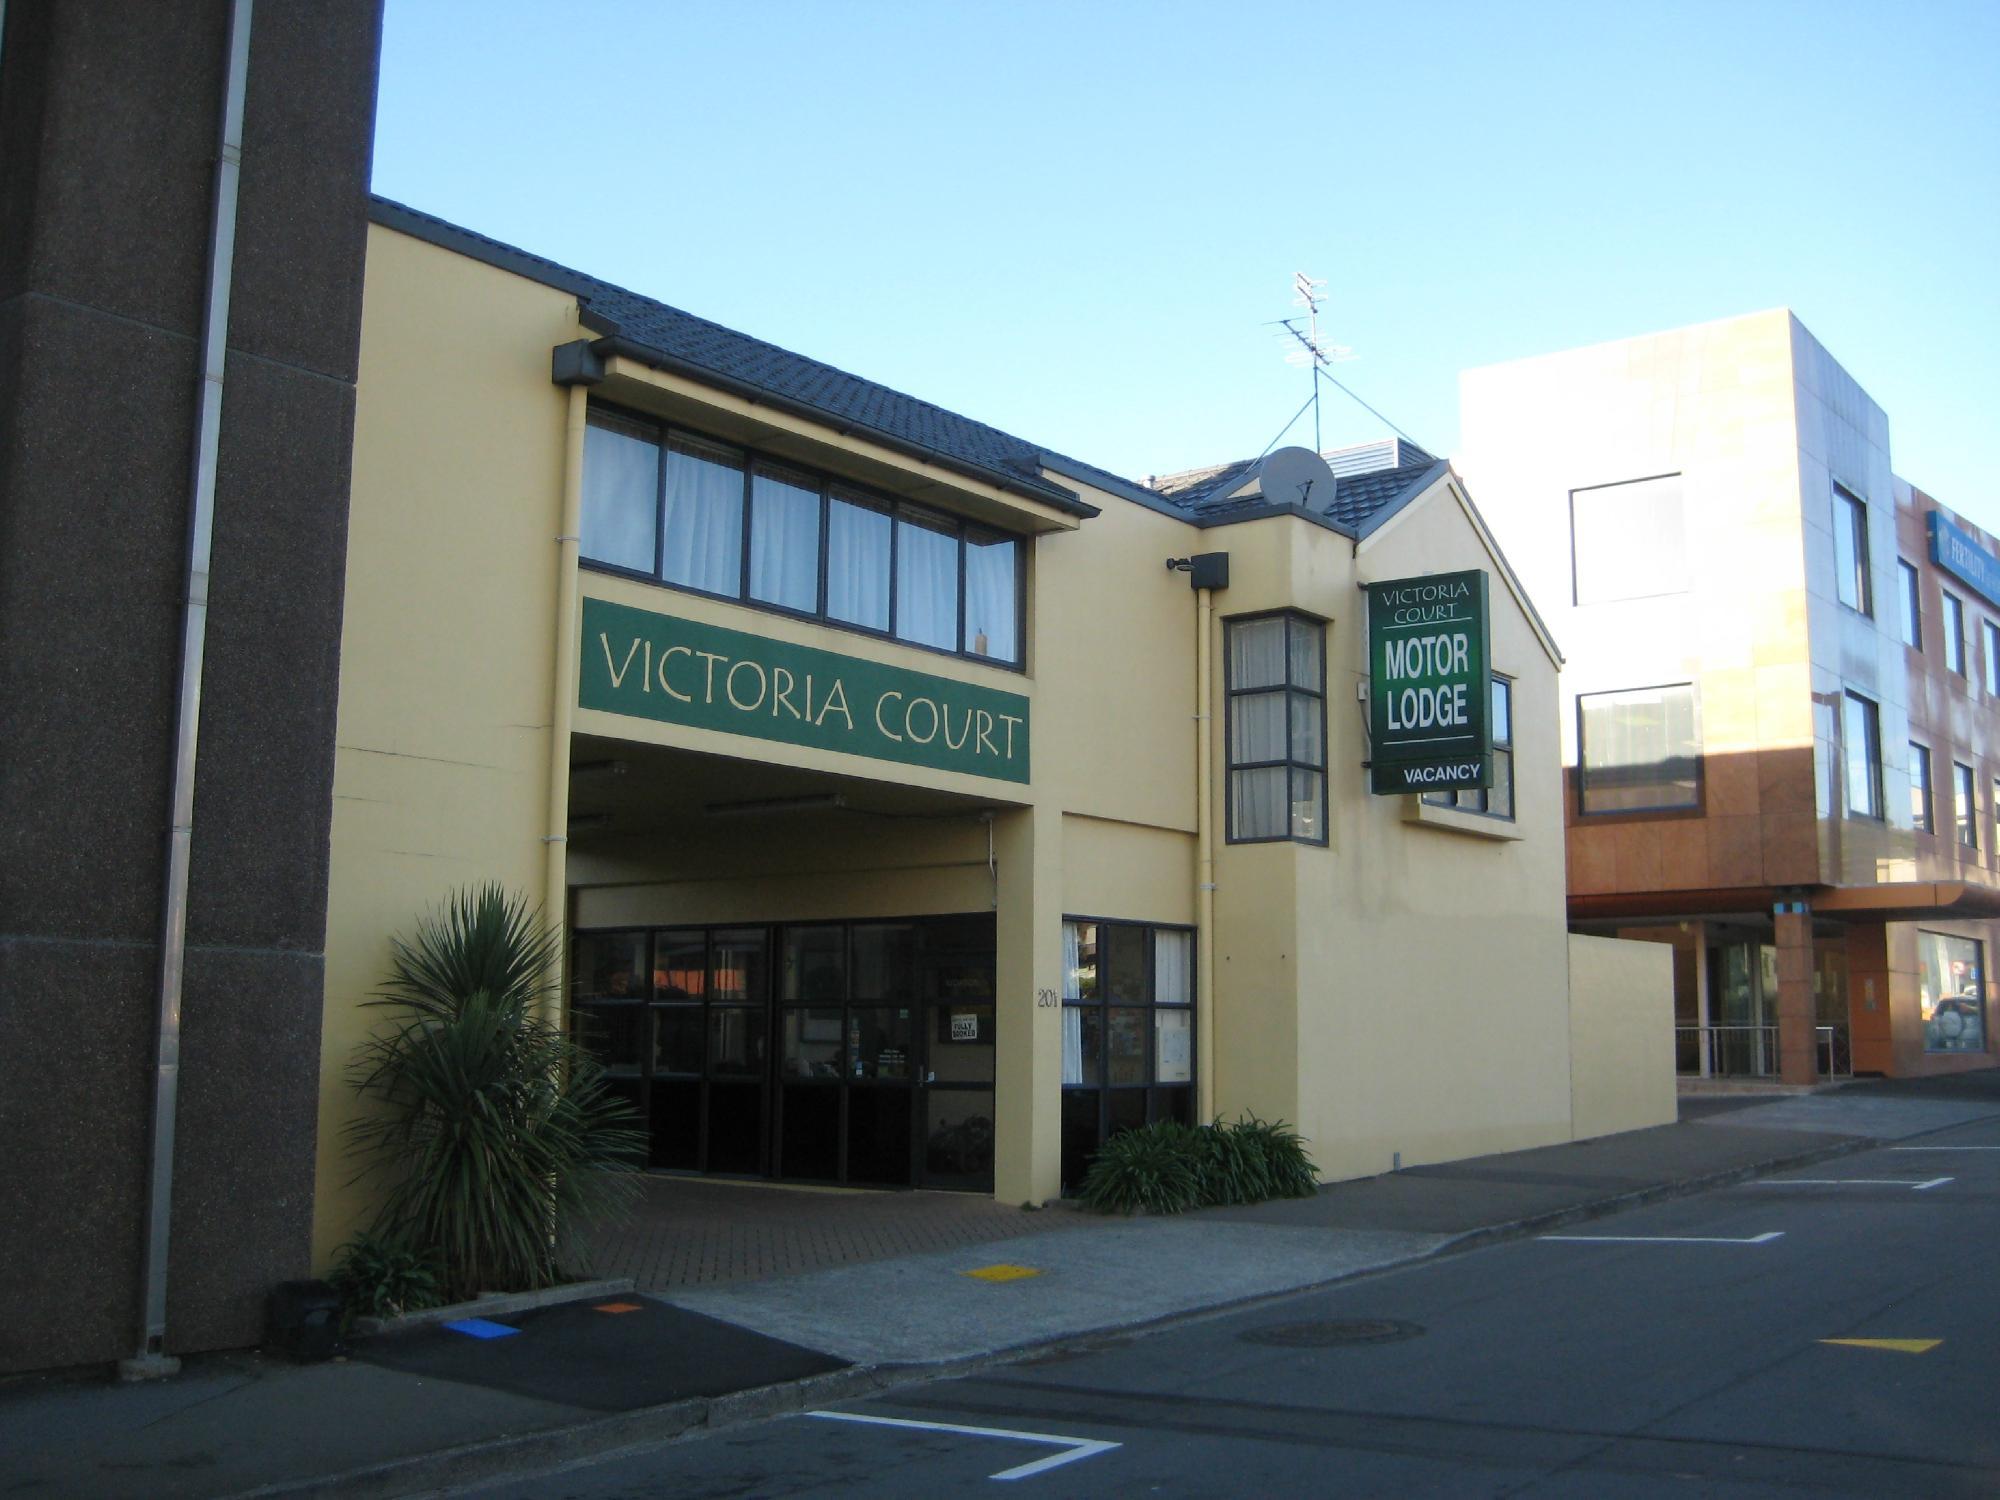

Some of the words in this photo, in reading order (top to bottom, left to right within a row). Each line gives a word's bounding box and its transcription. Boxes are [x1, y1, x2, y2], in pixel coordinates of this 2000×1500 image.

[1382, 581, 1470, 606] VICTORIA
[1394, 602, 1458, 625] COURT
[1385, 633, 1469, 681] MOTOR
[599, 631, 854, 730] VICTORIA
[875, 690, 1023, 759] COURT
[1387, 683, 1468, 731] LODGE
[1403, 763, 1481, 784] VACANCY
[1038, 989, 1058, 1008] 201
